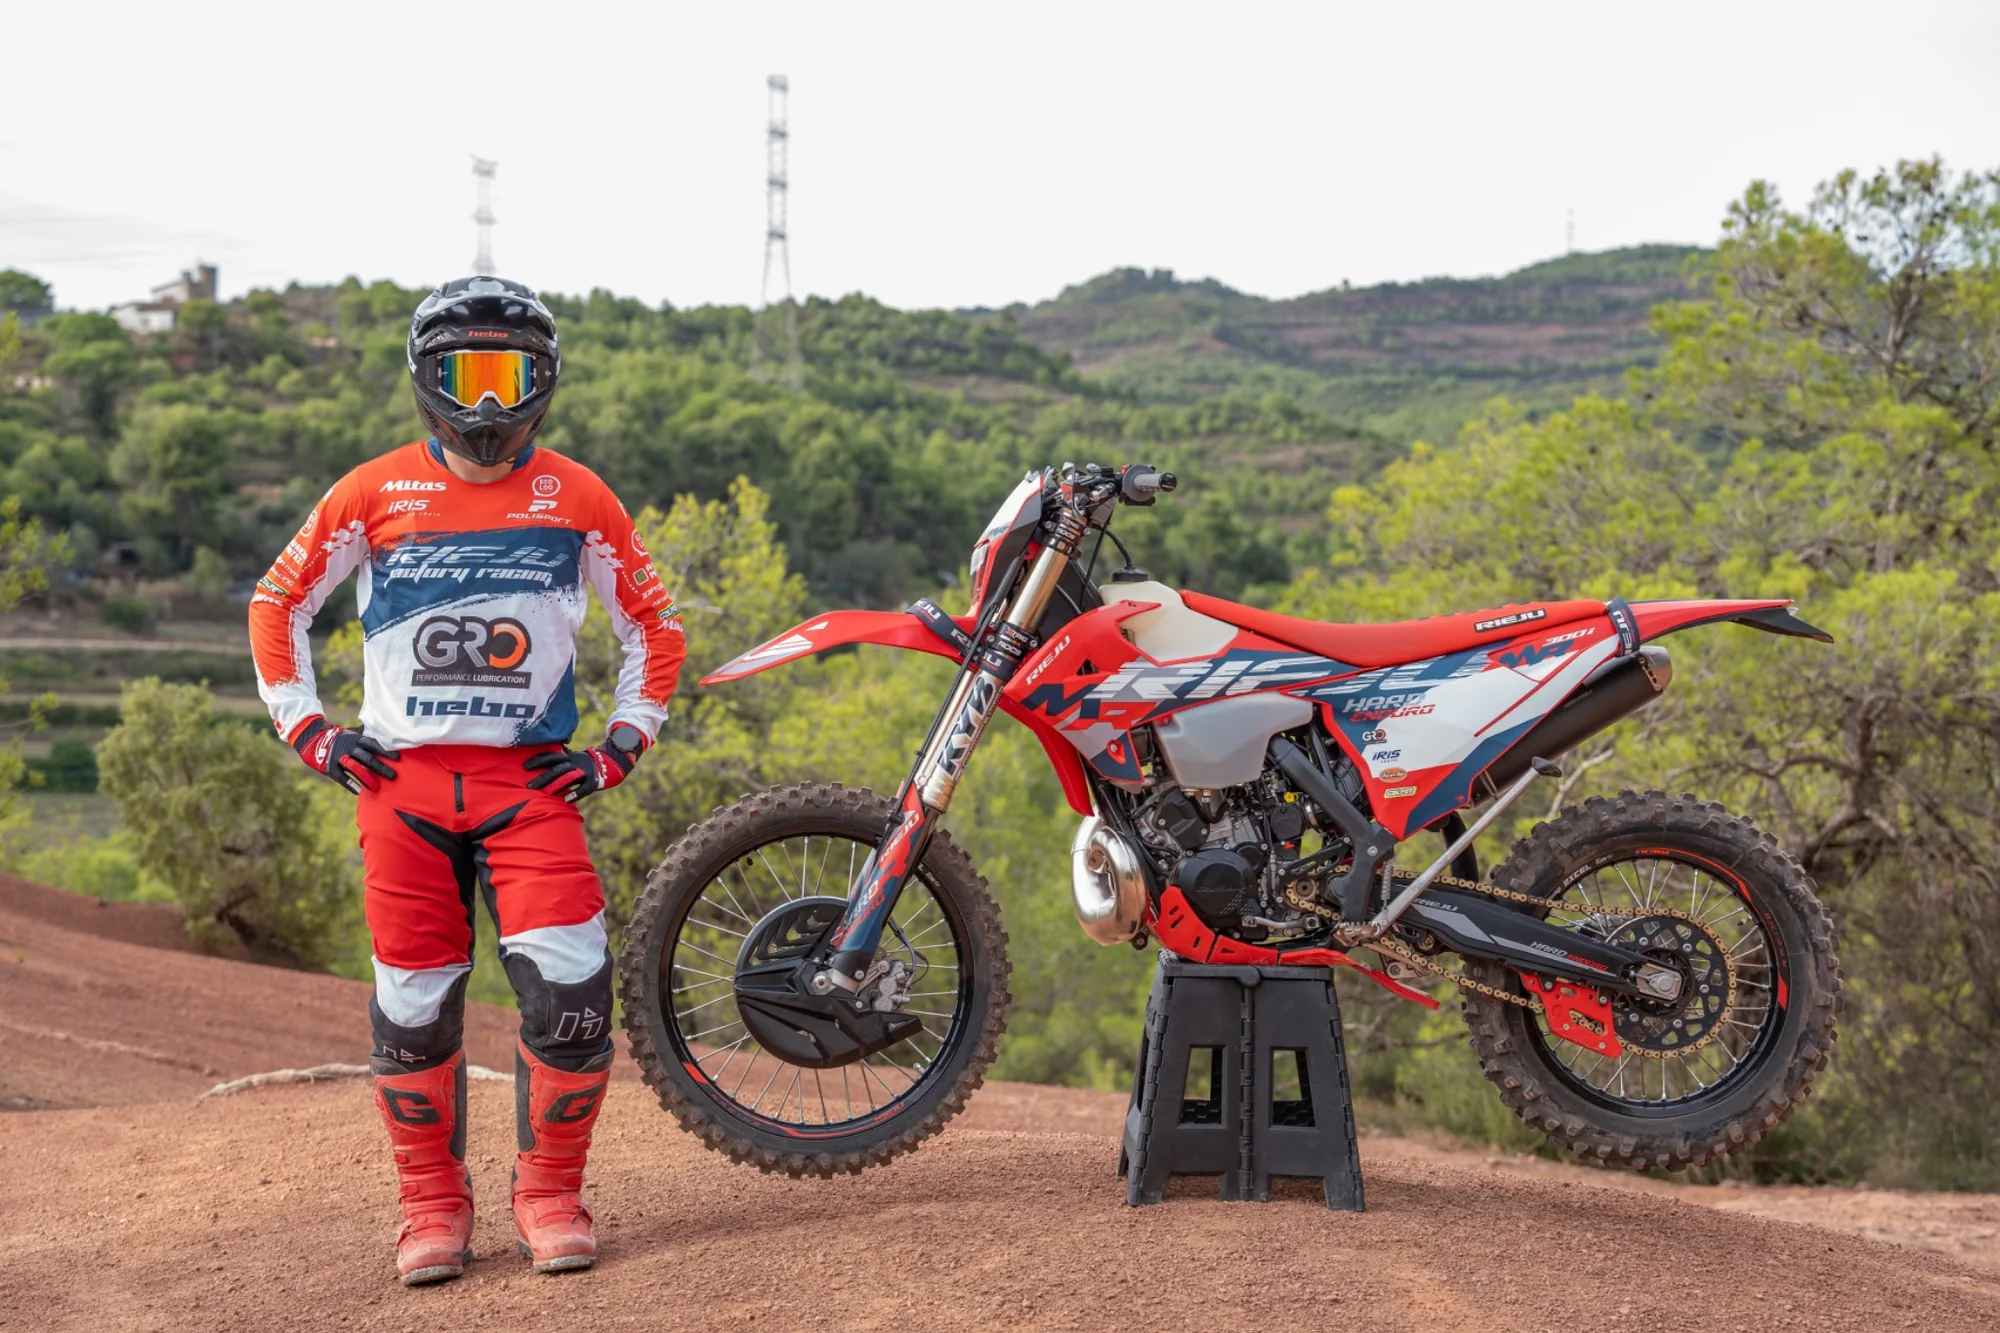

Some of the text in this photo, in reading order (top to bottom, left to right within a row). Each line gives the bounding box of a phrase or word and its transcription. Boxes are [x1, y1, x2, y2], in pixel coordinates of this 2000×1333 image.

[467, 330, 509, 339] hebo
[378, 479, 448, 493] Mitas
[506, 512, 572, 525] POLISPORT
[384, 545, 571, 568] RIEJU
[474, 567, 553, 589] racing
[1474, 609, 1546, 632] RIEJU
[415, 618, 530, 670] GRO
[1025, 634, 1071, 686] RIEJU
[415, 673, 527, 685] PERFORMANCE LUBRICATION
[405, 695, 537, 720] hebo
[1342, 692, 1427, 714] HARD
[1350, 703, 1436, 723] ENDURO
[935, 674, 996, 780] KYB
[1562, 864, 1592, 887] EXCEL
[1529, 940, 1568, 956] HARD
